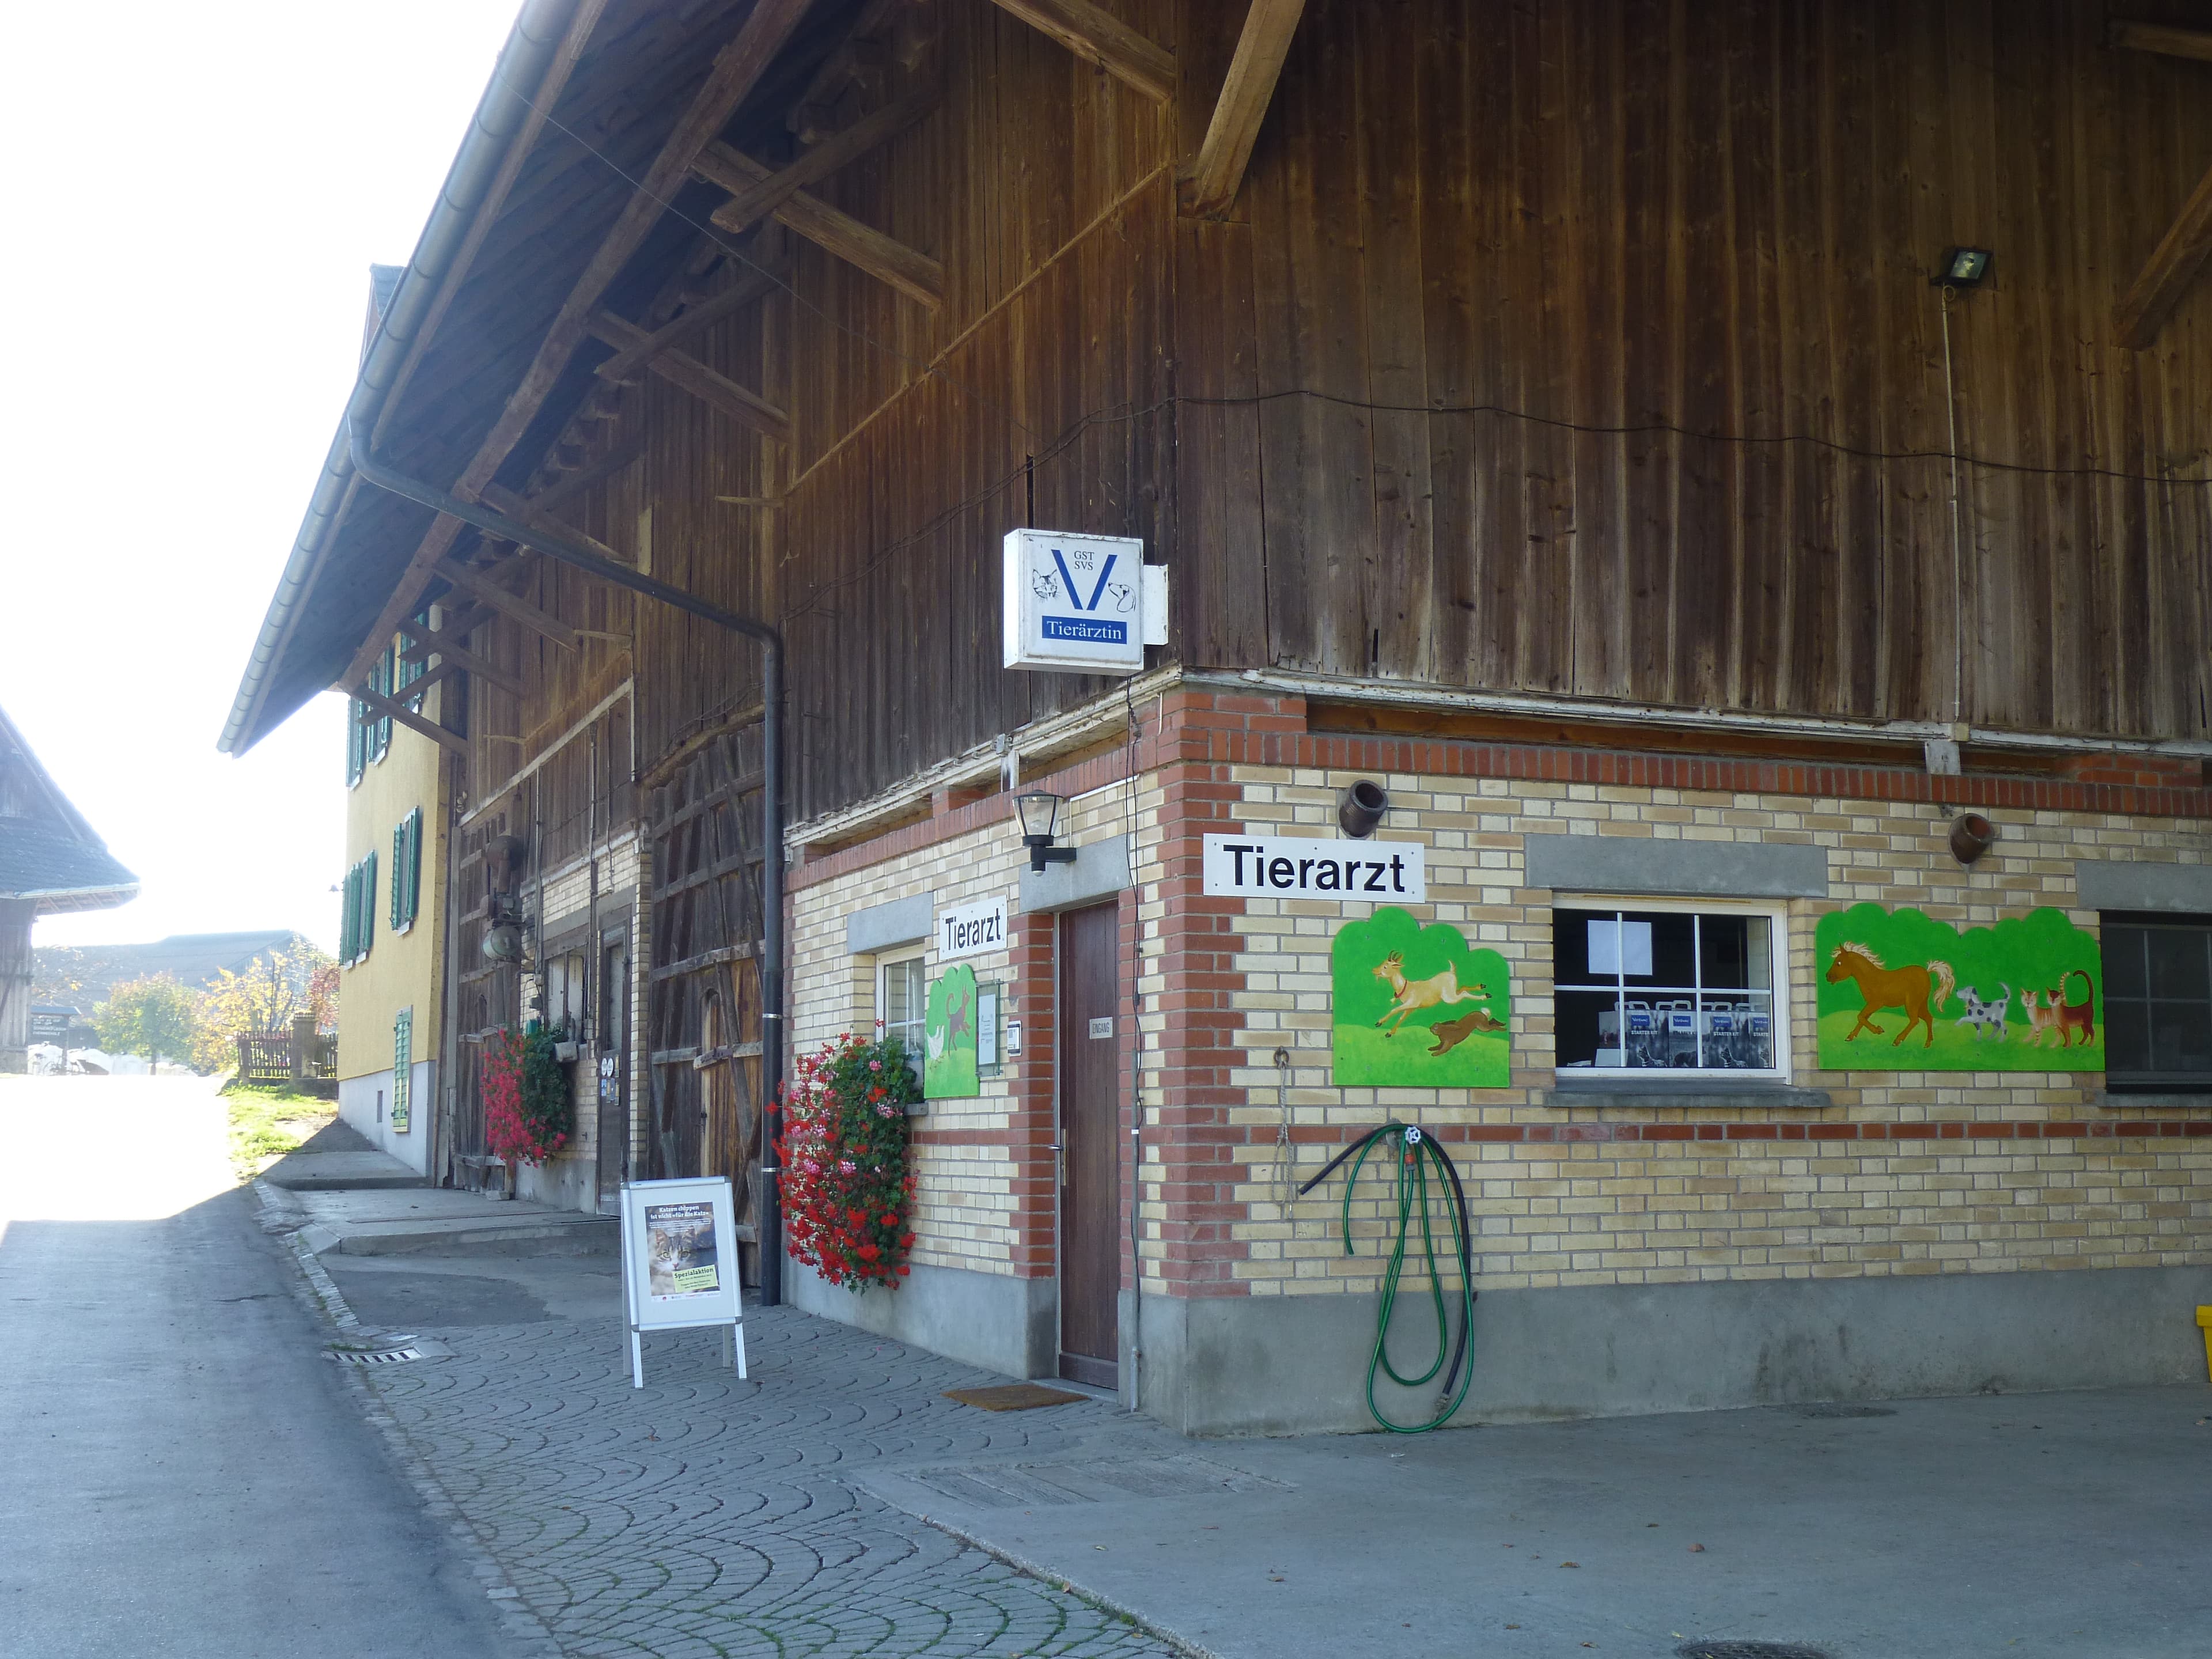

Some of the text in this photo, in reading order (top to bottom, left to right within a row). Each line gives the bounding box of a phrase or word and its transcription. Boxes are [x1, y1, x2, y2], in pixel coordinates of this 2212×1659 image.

[1074, 551, 1094, 560] GST
[1074, 560, 1093, 570] SVS
[1047, 621, 1122, 639] Tierärztin
[1223, 844, 1405, 892] Tierarzt
[945, 908, 1001, 950] Tierarzt
[1092, 1022, 1109, 1033] EINGANG
[675, 1268, 714, 1279] Spezialaktion
